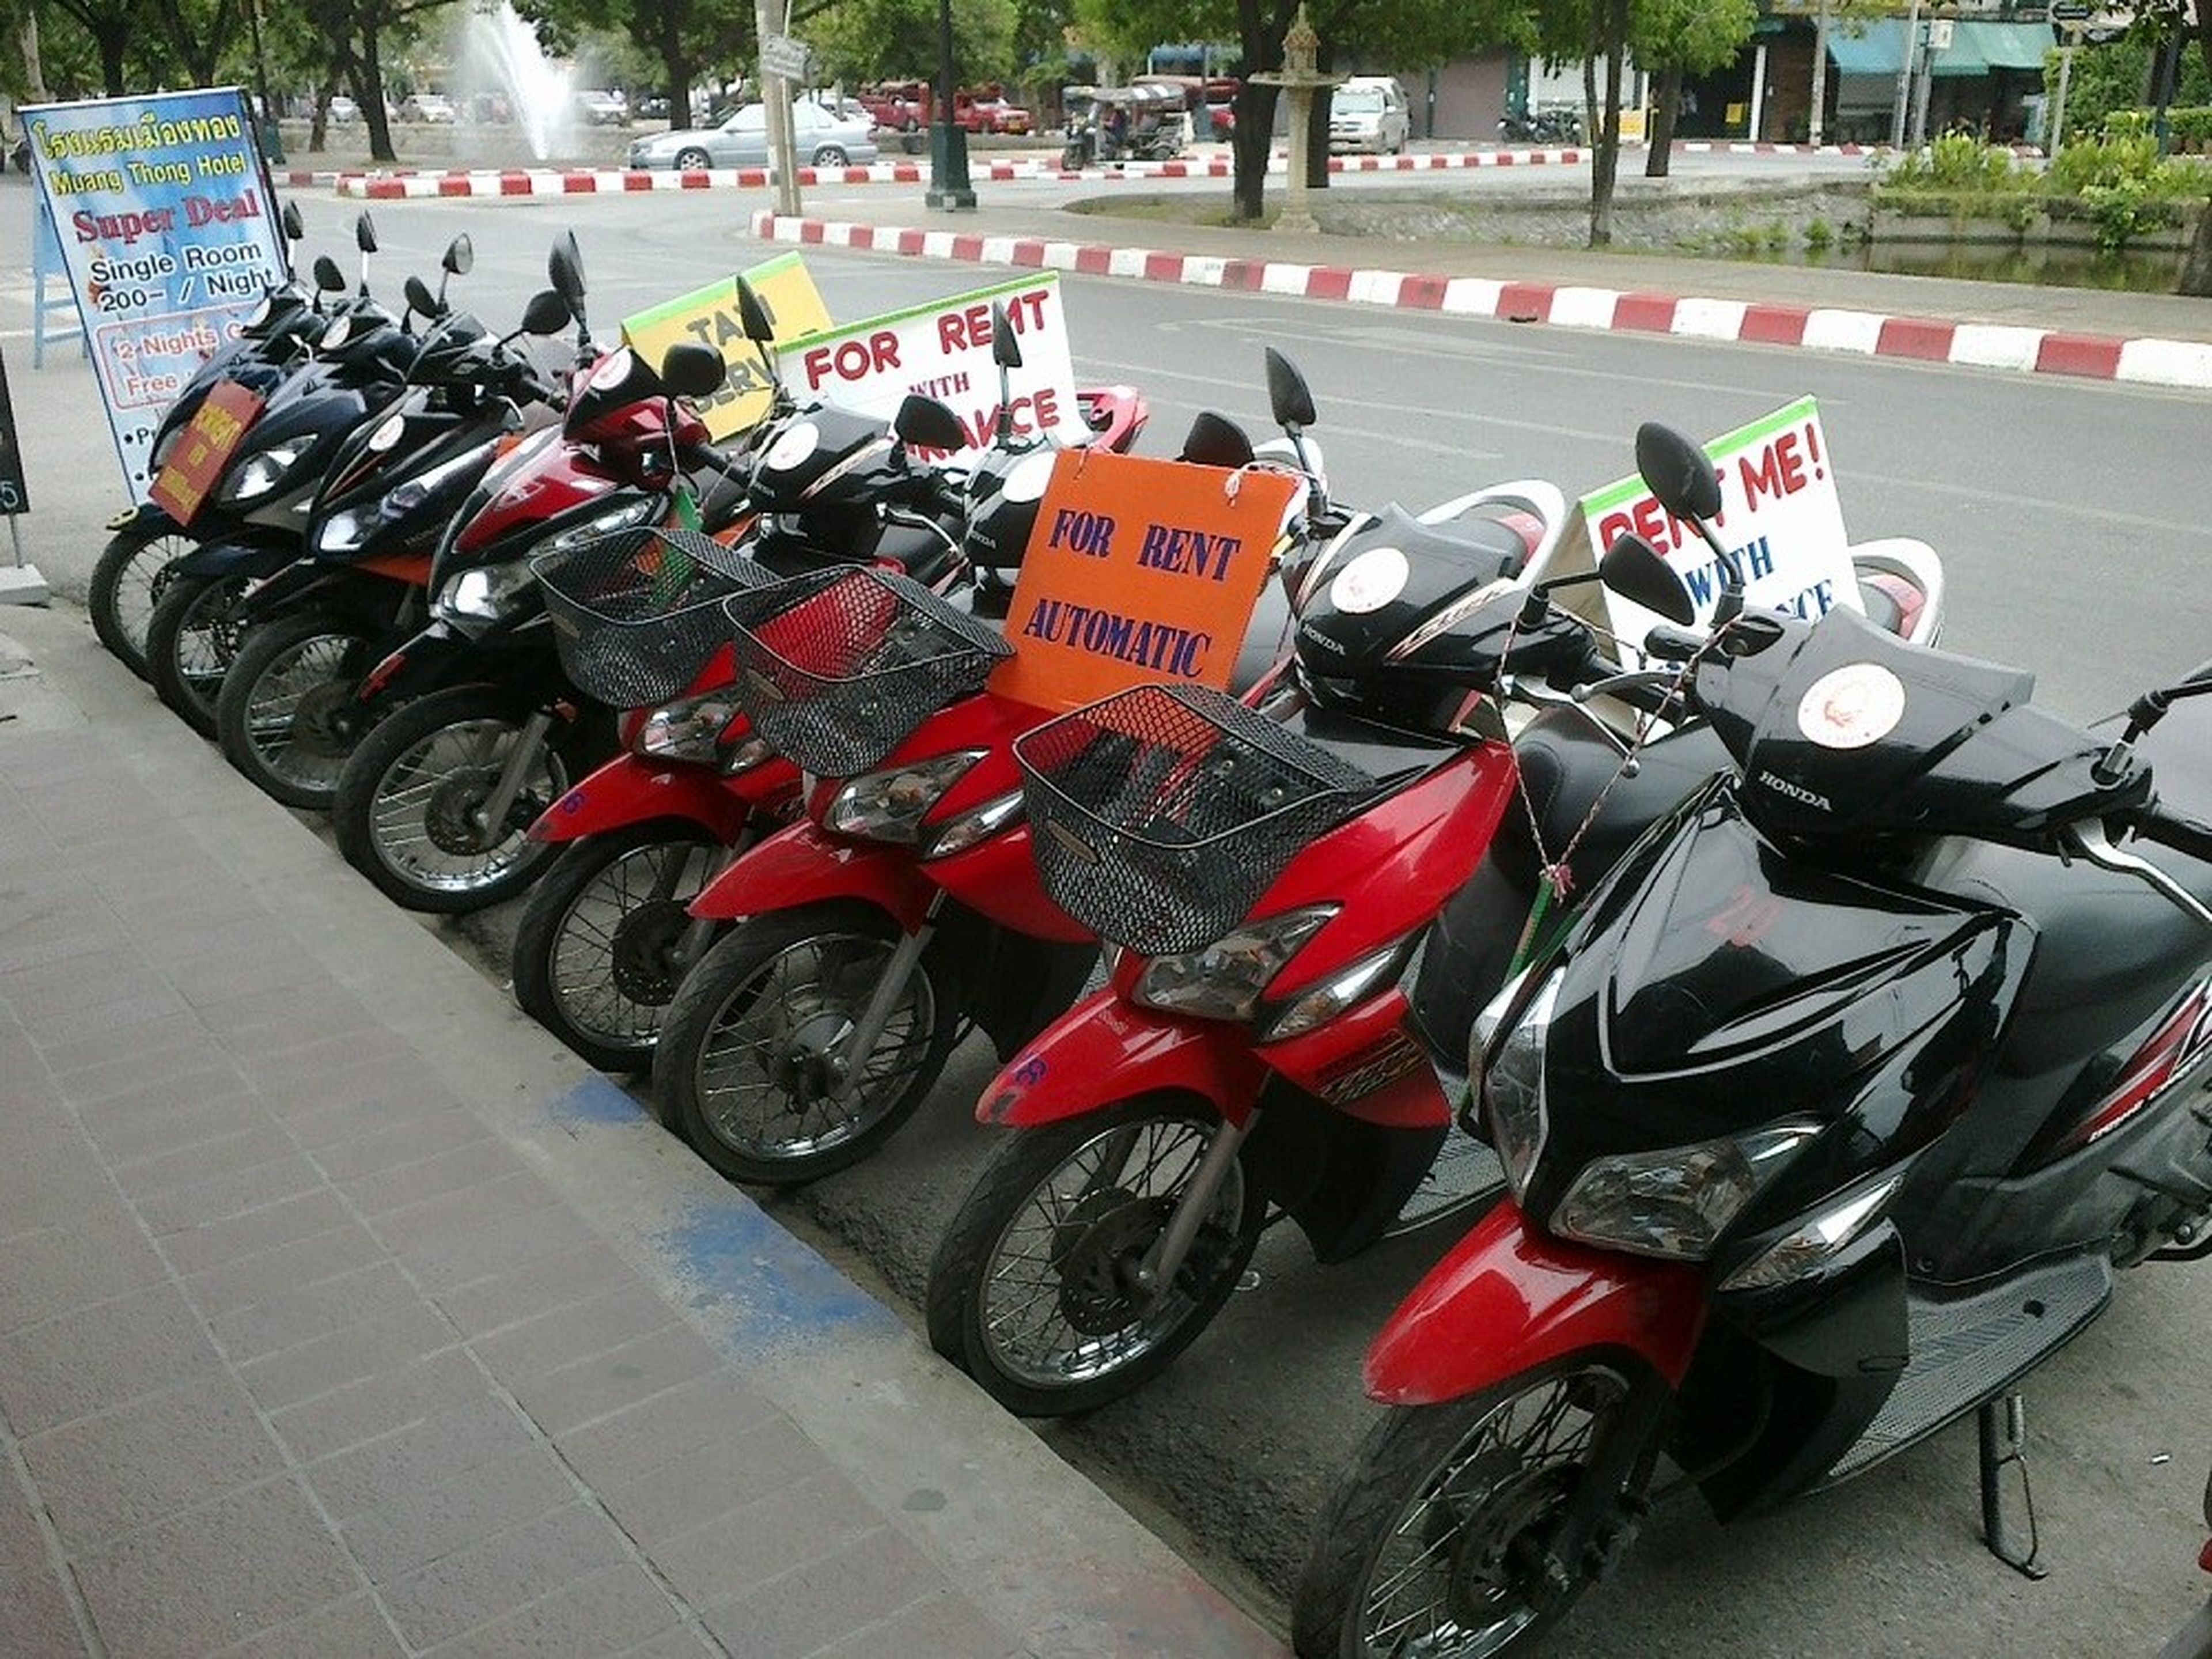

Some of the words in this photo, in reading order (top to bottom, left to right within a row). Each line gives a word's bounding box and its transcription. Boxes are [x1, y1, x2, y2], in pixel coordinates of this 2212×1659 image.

[51, 171, 124, 197] Muang
[127, 160, 192, 187] Thong
[196, 151, 247, 176] Hotel
[72, 209, 176, 244] Super
[181, 188, 260, 227] Deal
[90, 253, 174, 283] Single
[185, 242, 263, 270] Room
[209, 267, 275, 297] Night
[685, 294, 777, 347] TAI
[118, 342, 135, 360] 2
[143, 330, 217, 357] Nights
[804, 331, 902, 391] FOR
[125, 374, 178, 397] Free
[1738, 422, 1824, 513] ME!
[1048, 507, 1116, 558] FOR
[1137, 523, 1243, 582] RENT
[1023, 597, 1213, 679] AUTOMATIC
[1302, 624, 1346, 656] HONDA
[1759, 770, 1832, 812] HONDA
